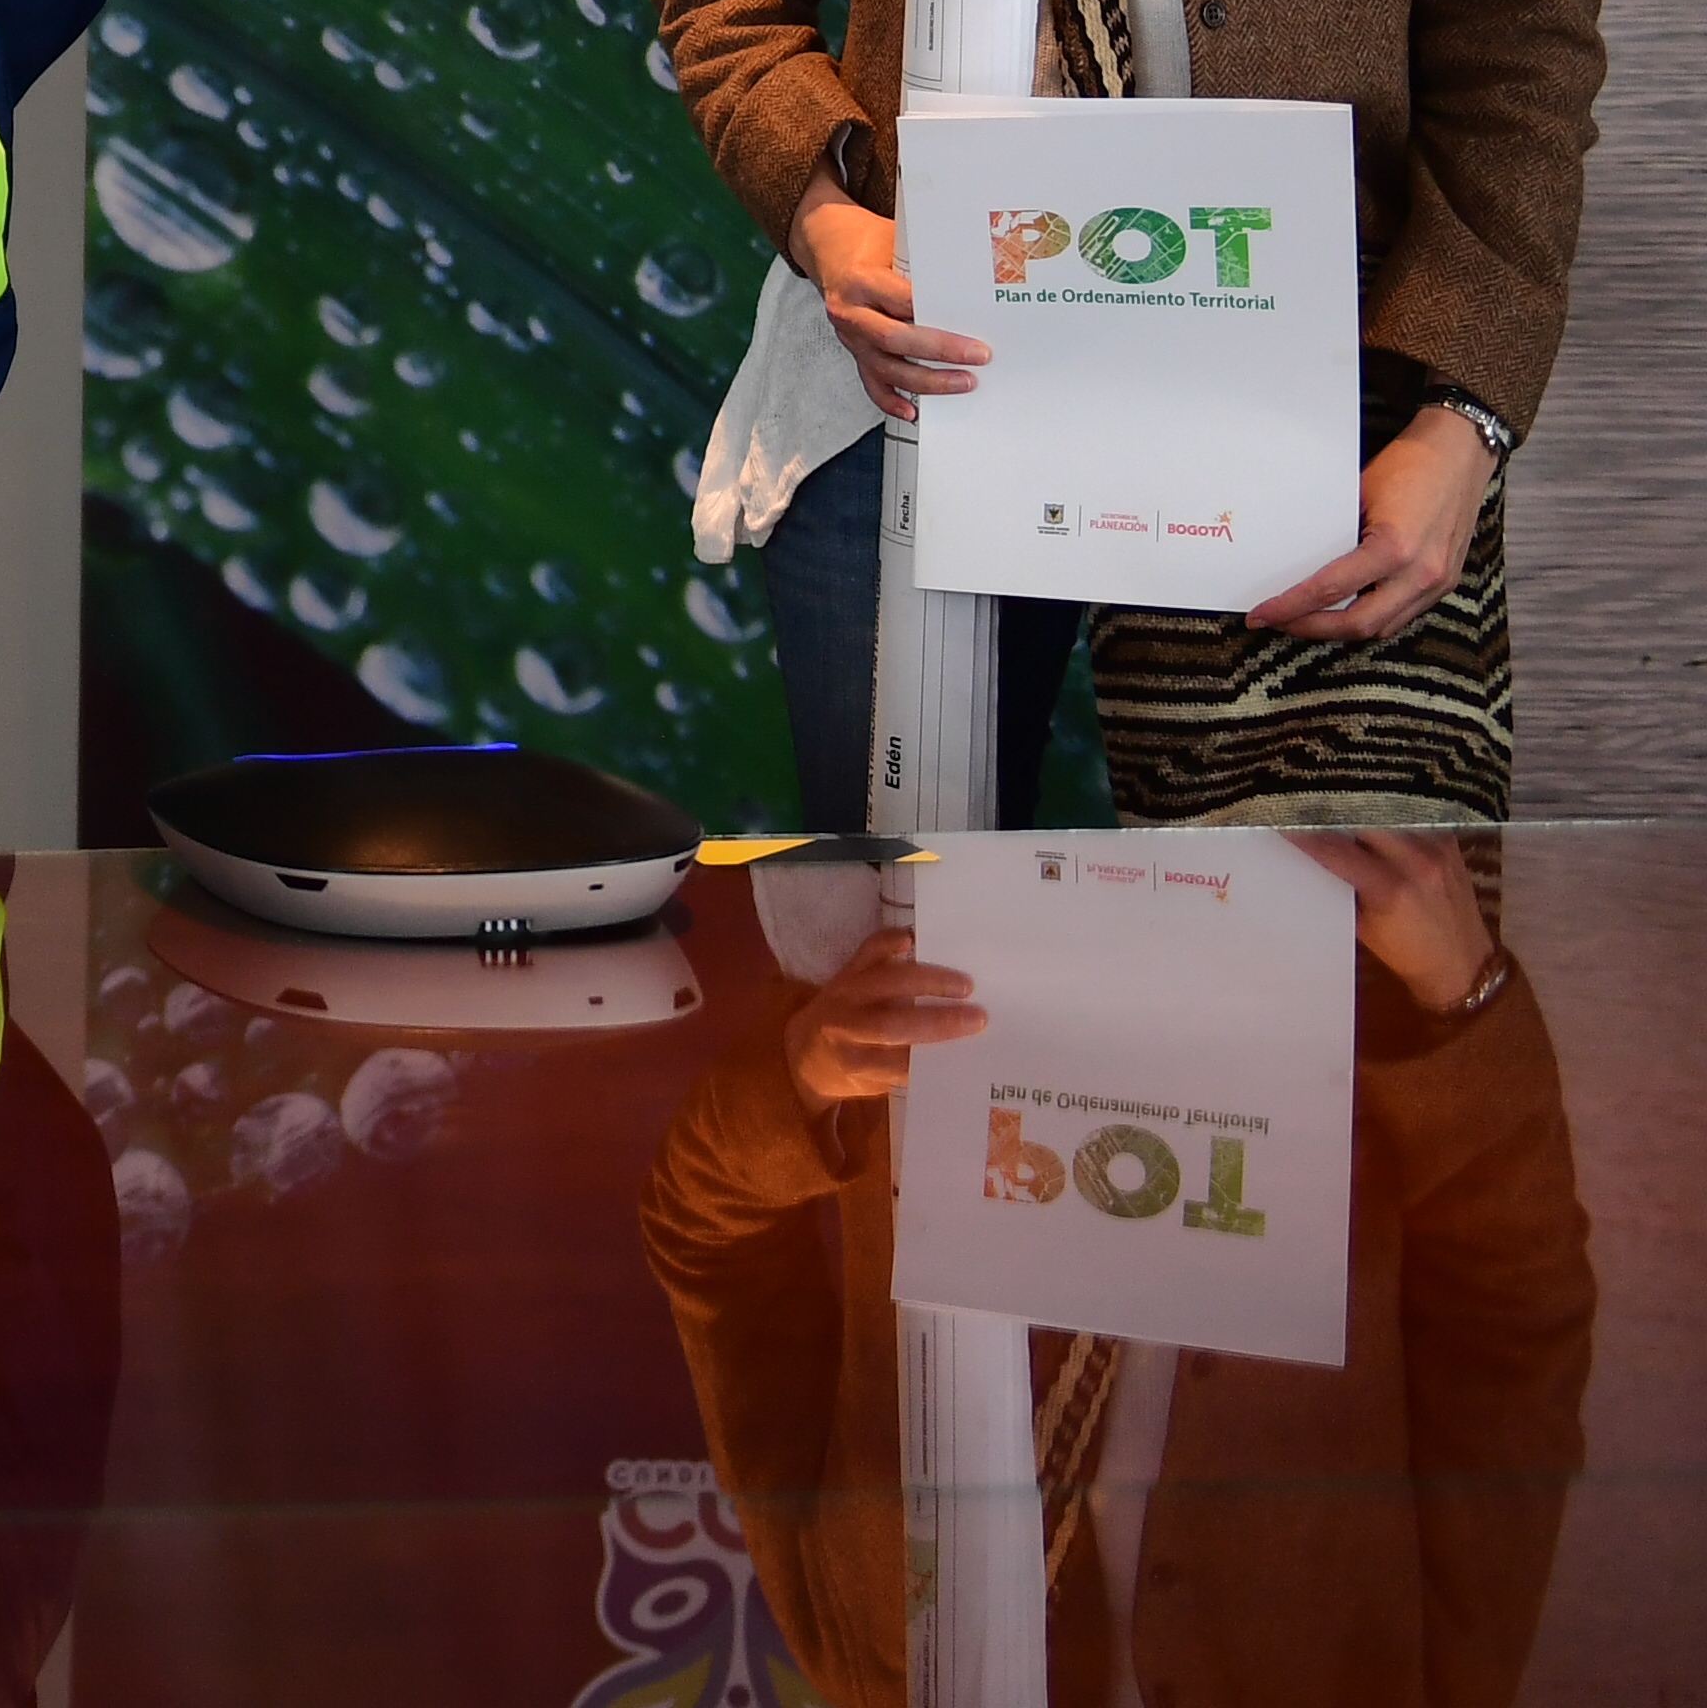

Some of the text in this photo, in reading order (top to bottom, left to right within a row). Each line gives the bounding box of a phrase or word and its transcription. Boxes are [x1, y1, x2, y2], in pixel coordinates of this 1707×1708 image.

[988, 207, 1272, 288] POT
[995, 289, 1275, 310] Plan de Ordenamiento Territorial
[900, 491, 910, 531] Fecha:
[885, 735, 901, 790] Edén
